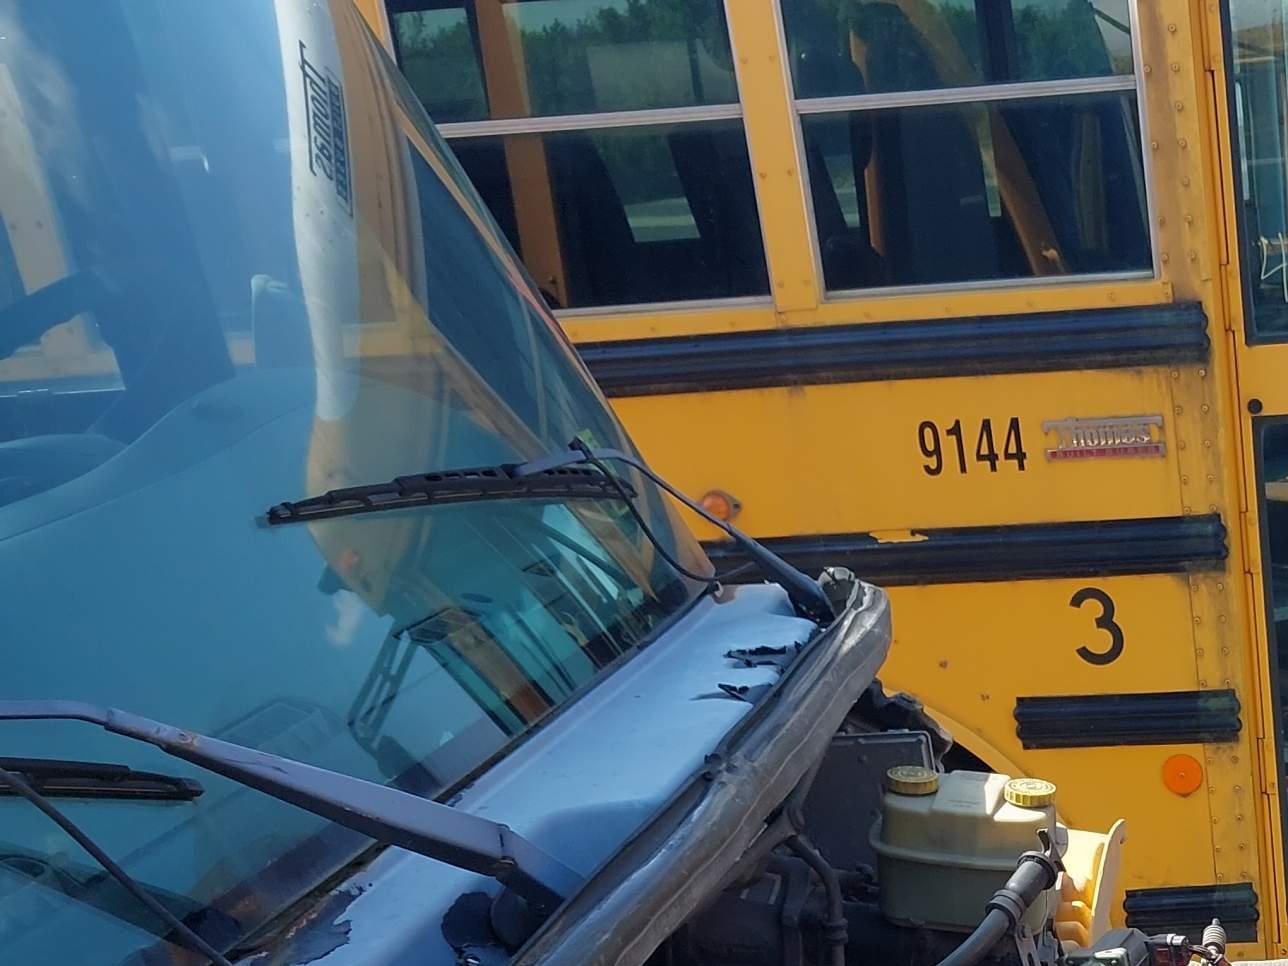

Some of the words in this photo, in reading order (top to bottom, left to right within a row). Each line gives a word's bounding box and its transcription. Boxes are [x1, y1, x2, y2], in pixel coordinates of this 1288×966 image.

[918, 416, 1028, 477] 9144
[1041, 416, 1163, 449] Thomas
[1069, 587, 1125, 666] 3
